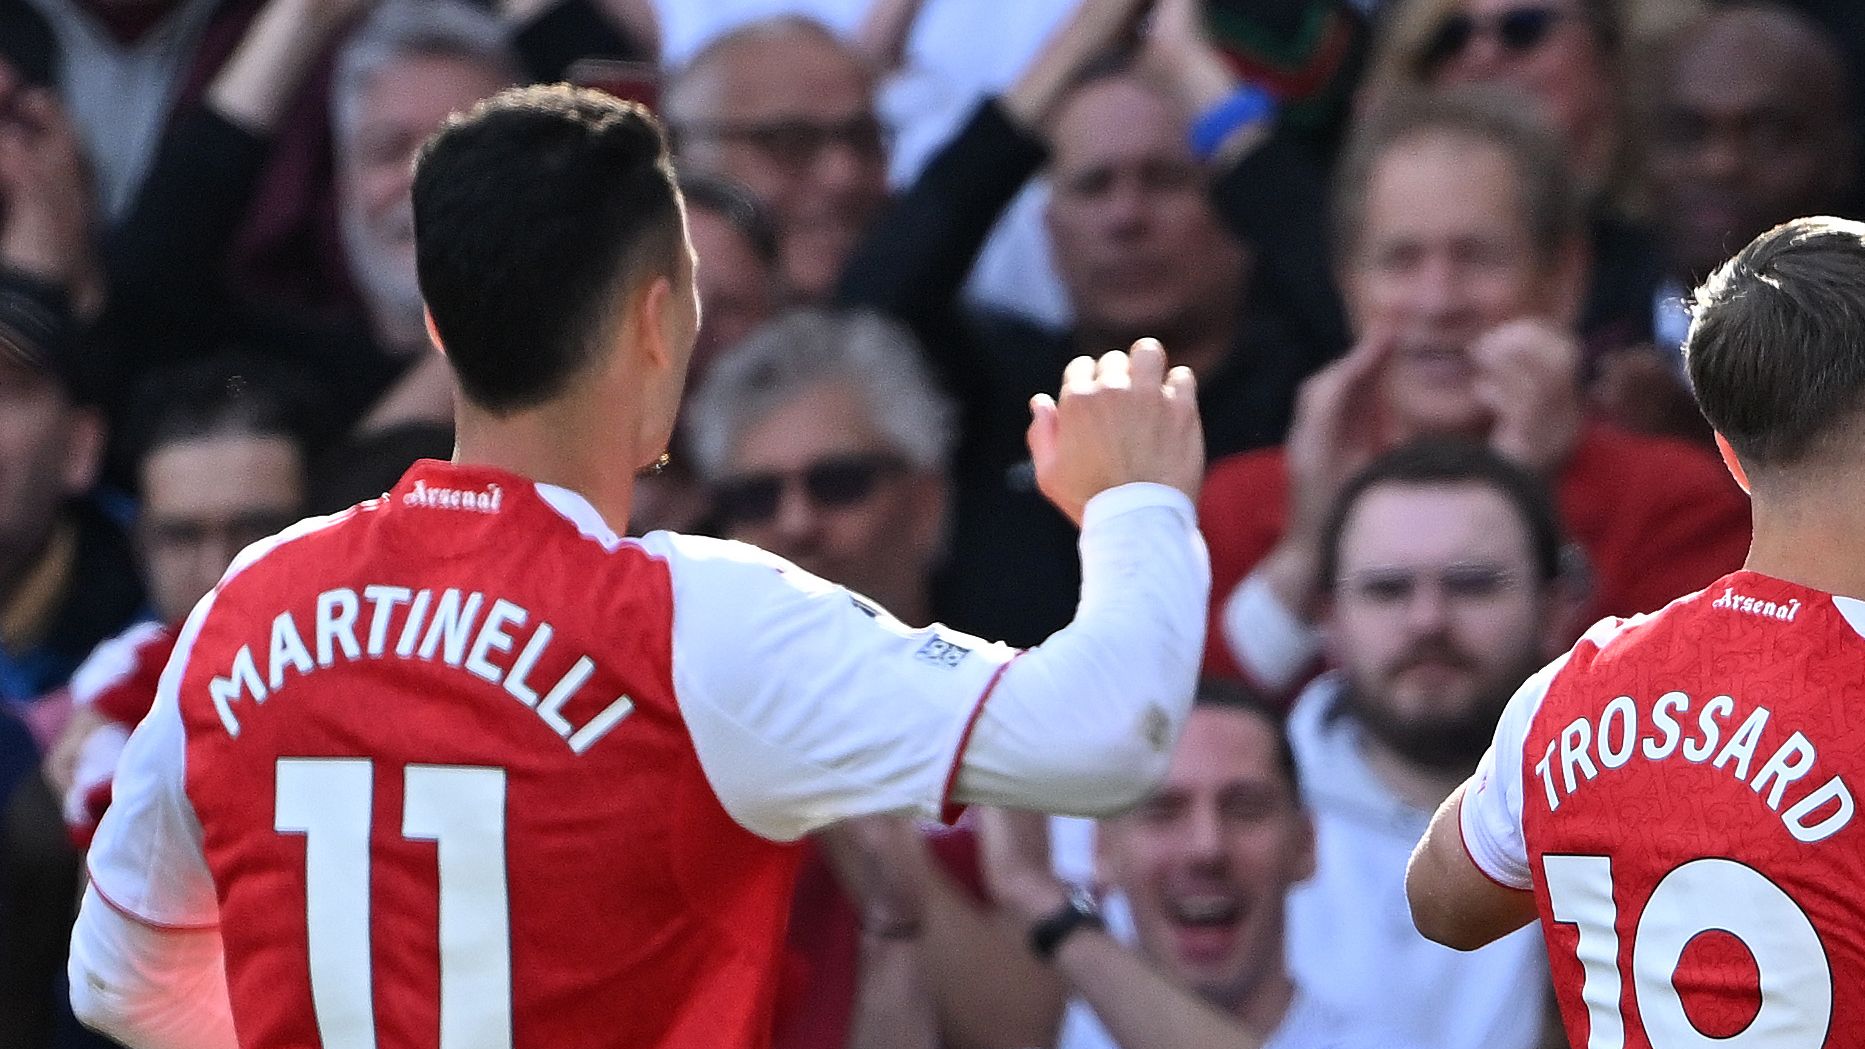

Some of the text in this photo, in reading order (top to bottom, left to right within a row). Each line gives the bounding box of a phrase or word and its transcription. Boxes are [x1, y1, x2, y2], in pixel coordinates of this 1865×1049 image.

[402, 479, 503, 514] Arsenal
[1711, 587, 1802, 622] Arsenal
[208, 582, 636, 755] MARTINELLI
[1534, 690, 1856, 844] TROSSARD
